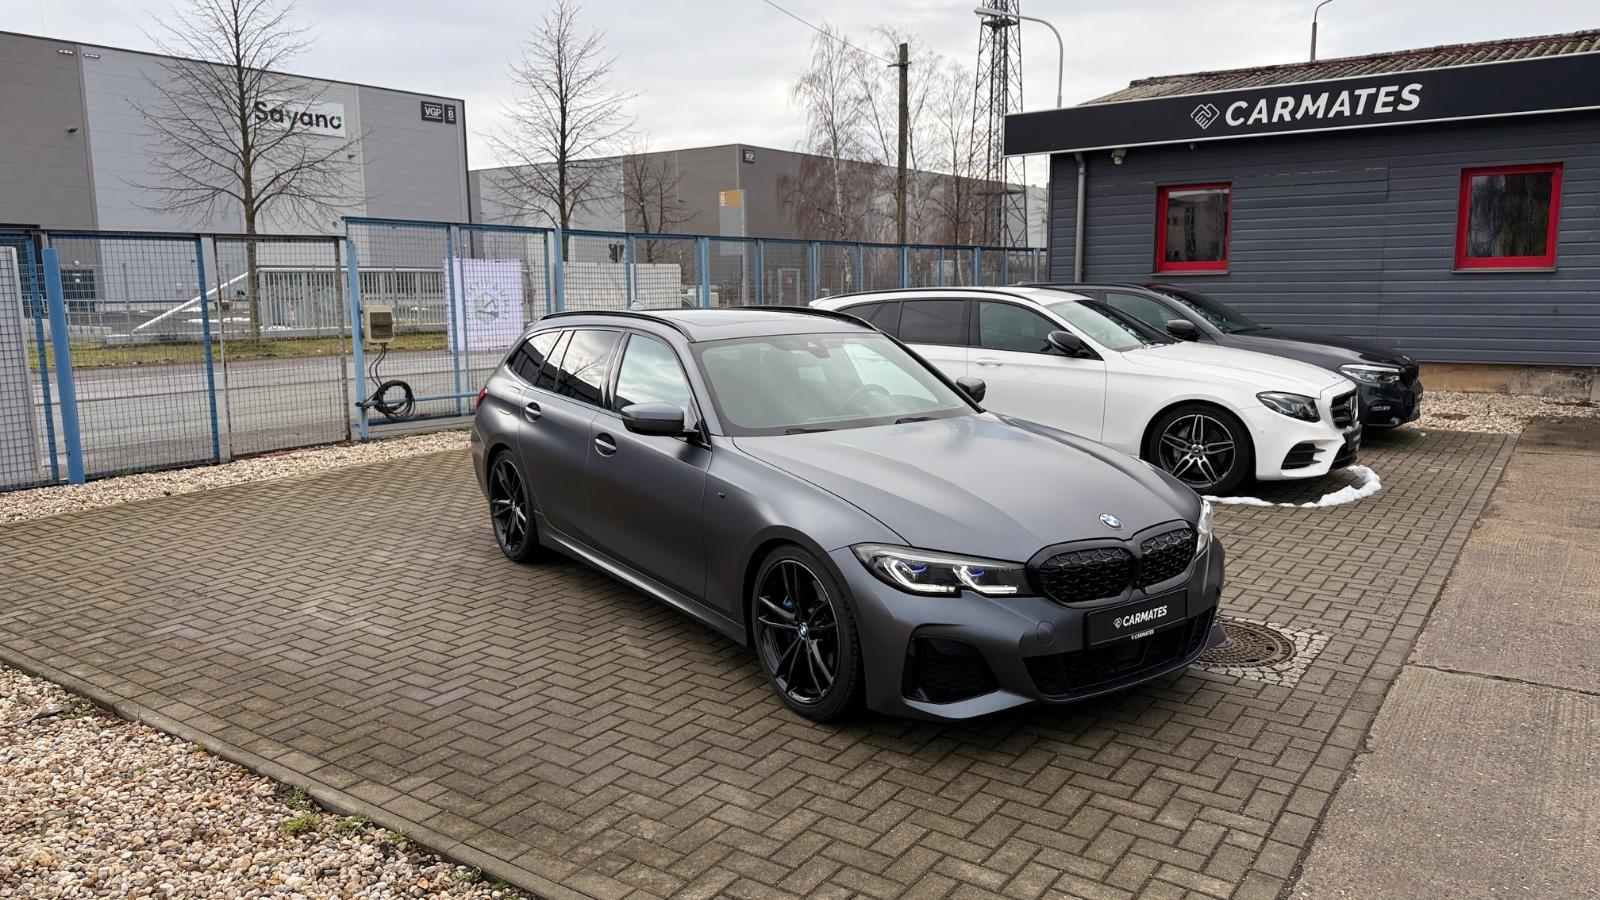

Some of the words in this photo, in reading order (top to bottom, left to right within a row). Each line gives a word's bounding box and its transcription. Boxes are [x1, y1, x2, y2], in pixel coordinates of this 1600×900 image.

[424, 106, 442, 117] VGP
[1225, 83, 1423, 126] CARMATES
[448, 110, 454, 119] B
[1122, 605, 1167, 626] CARMATES
